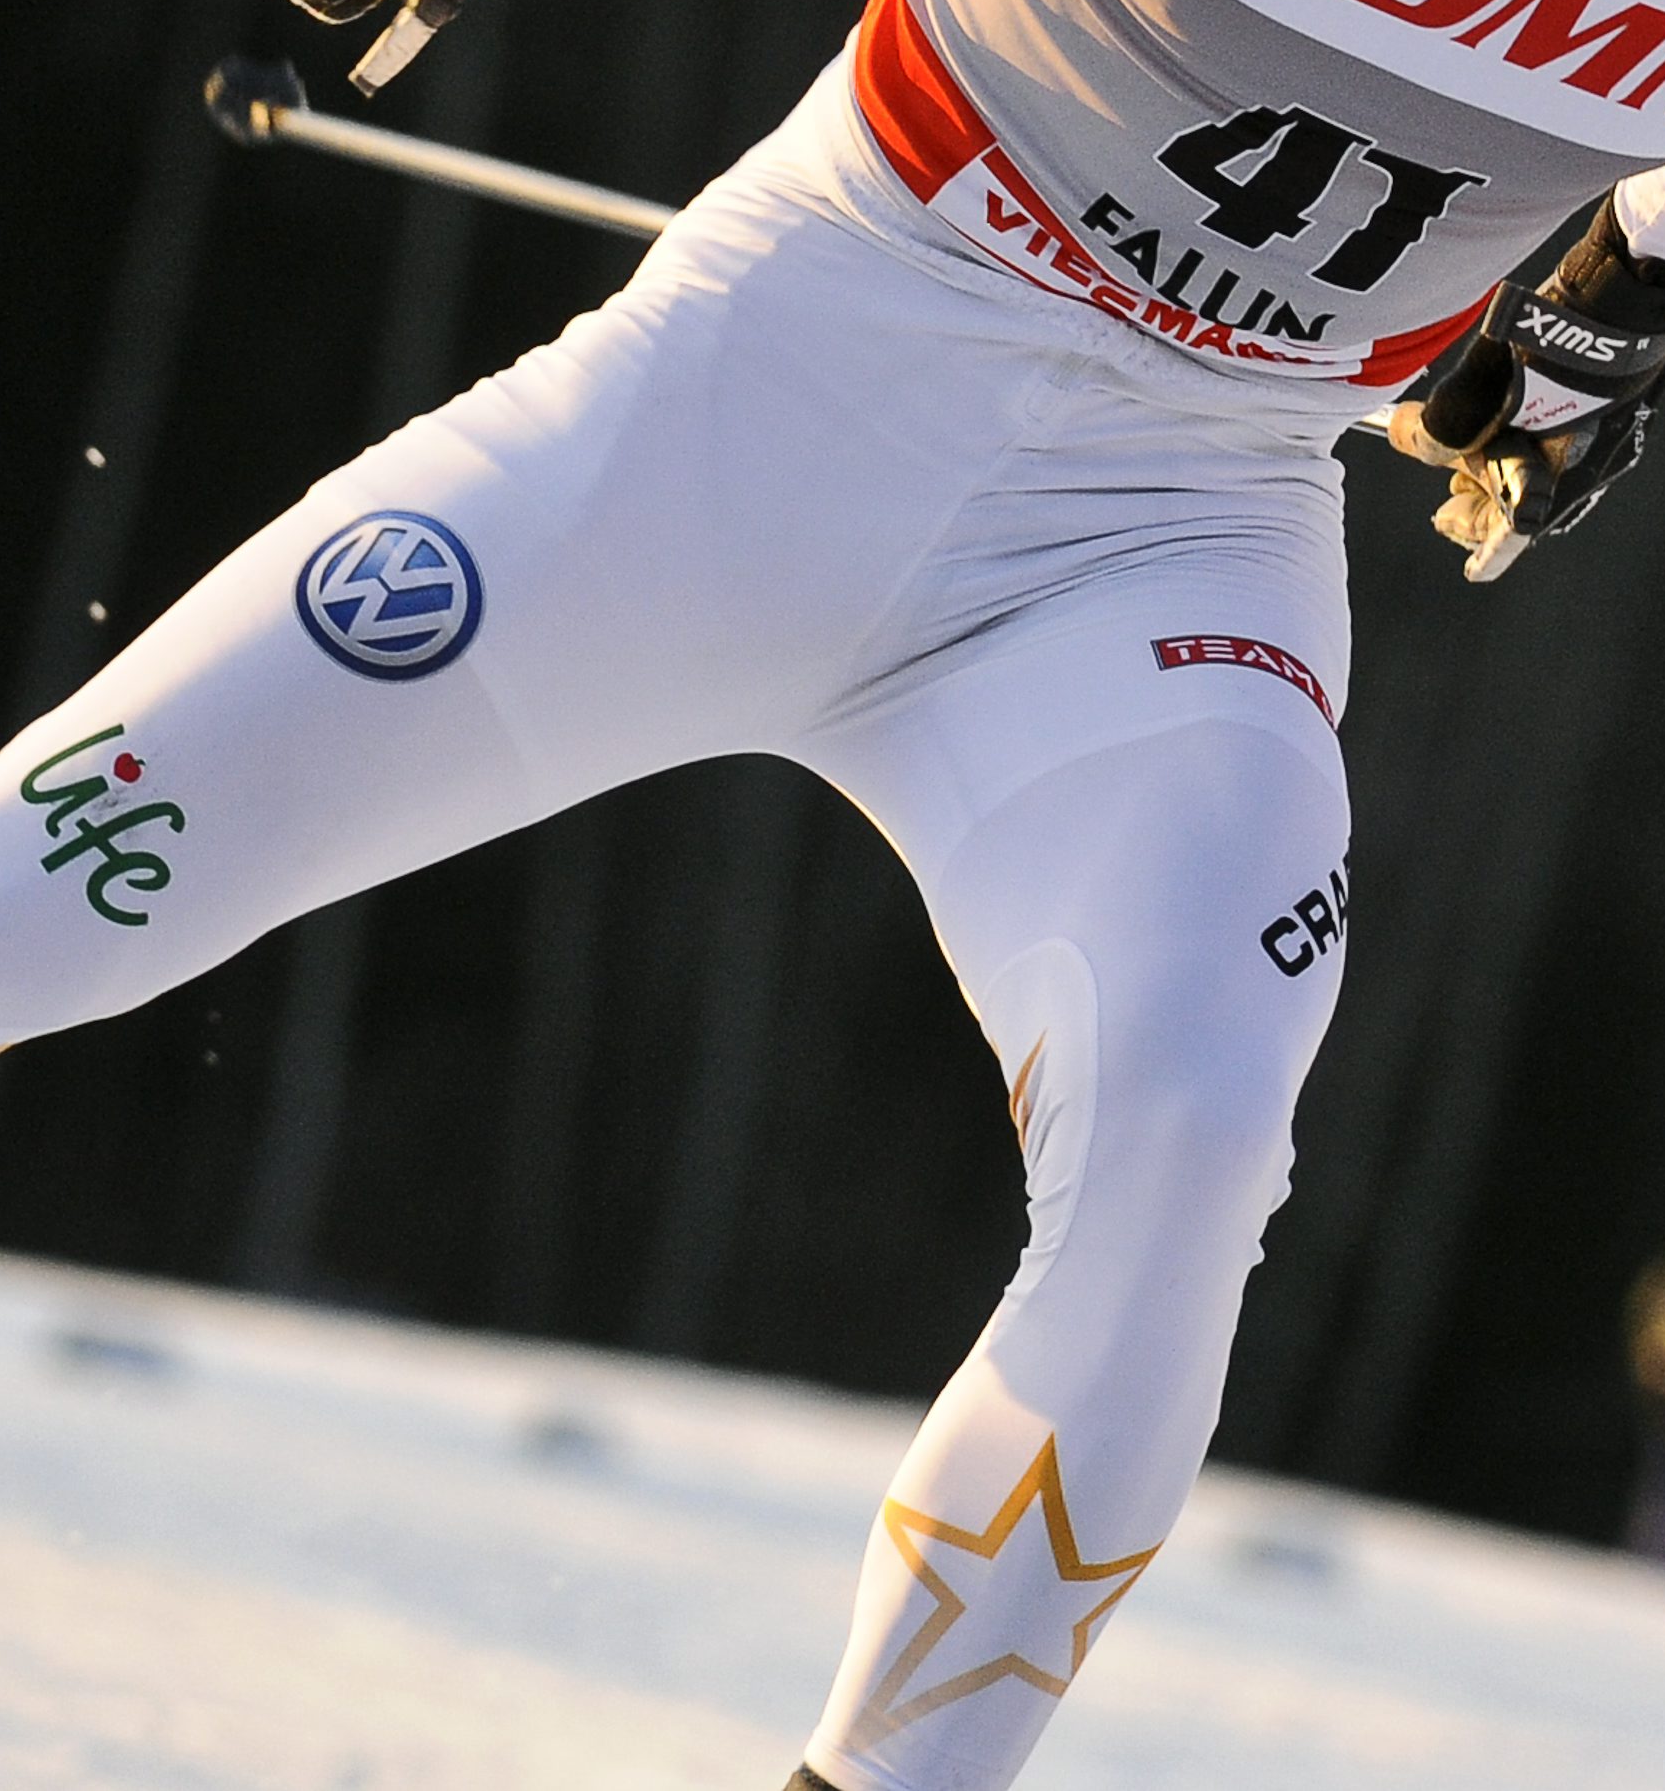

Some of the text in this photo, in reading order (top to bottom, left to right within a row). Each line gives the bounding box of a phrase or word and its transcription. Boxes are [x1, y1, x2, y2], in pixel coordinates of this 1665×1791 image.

[985, 188, 1313, 366] VIEMA
[1078, 192, 1337, 343] FALUN
[1155, 102, 1487, 294] 41
[1165, 637, 1317, 698] TEAM
[19, 722, 187, 927] Life
[1259, 855, 1350, 978] CRA
